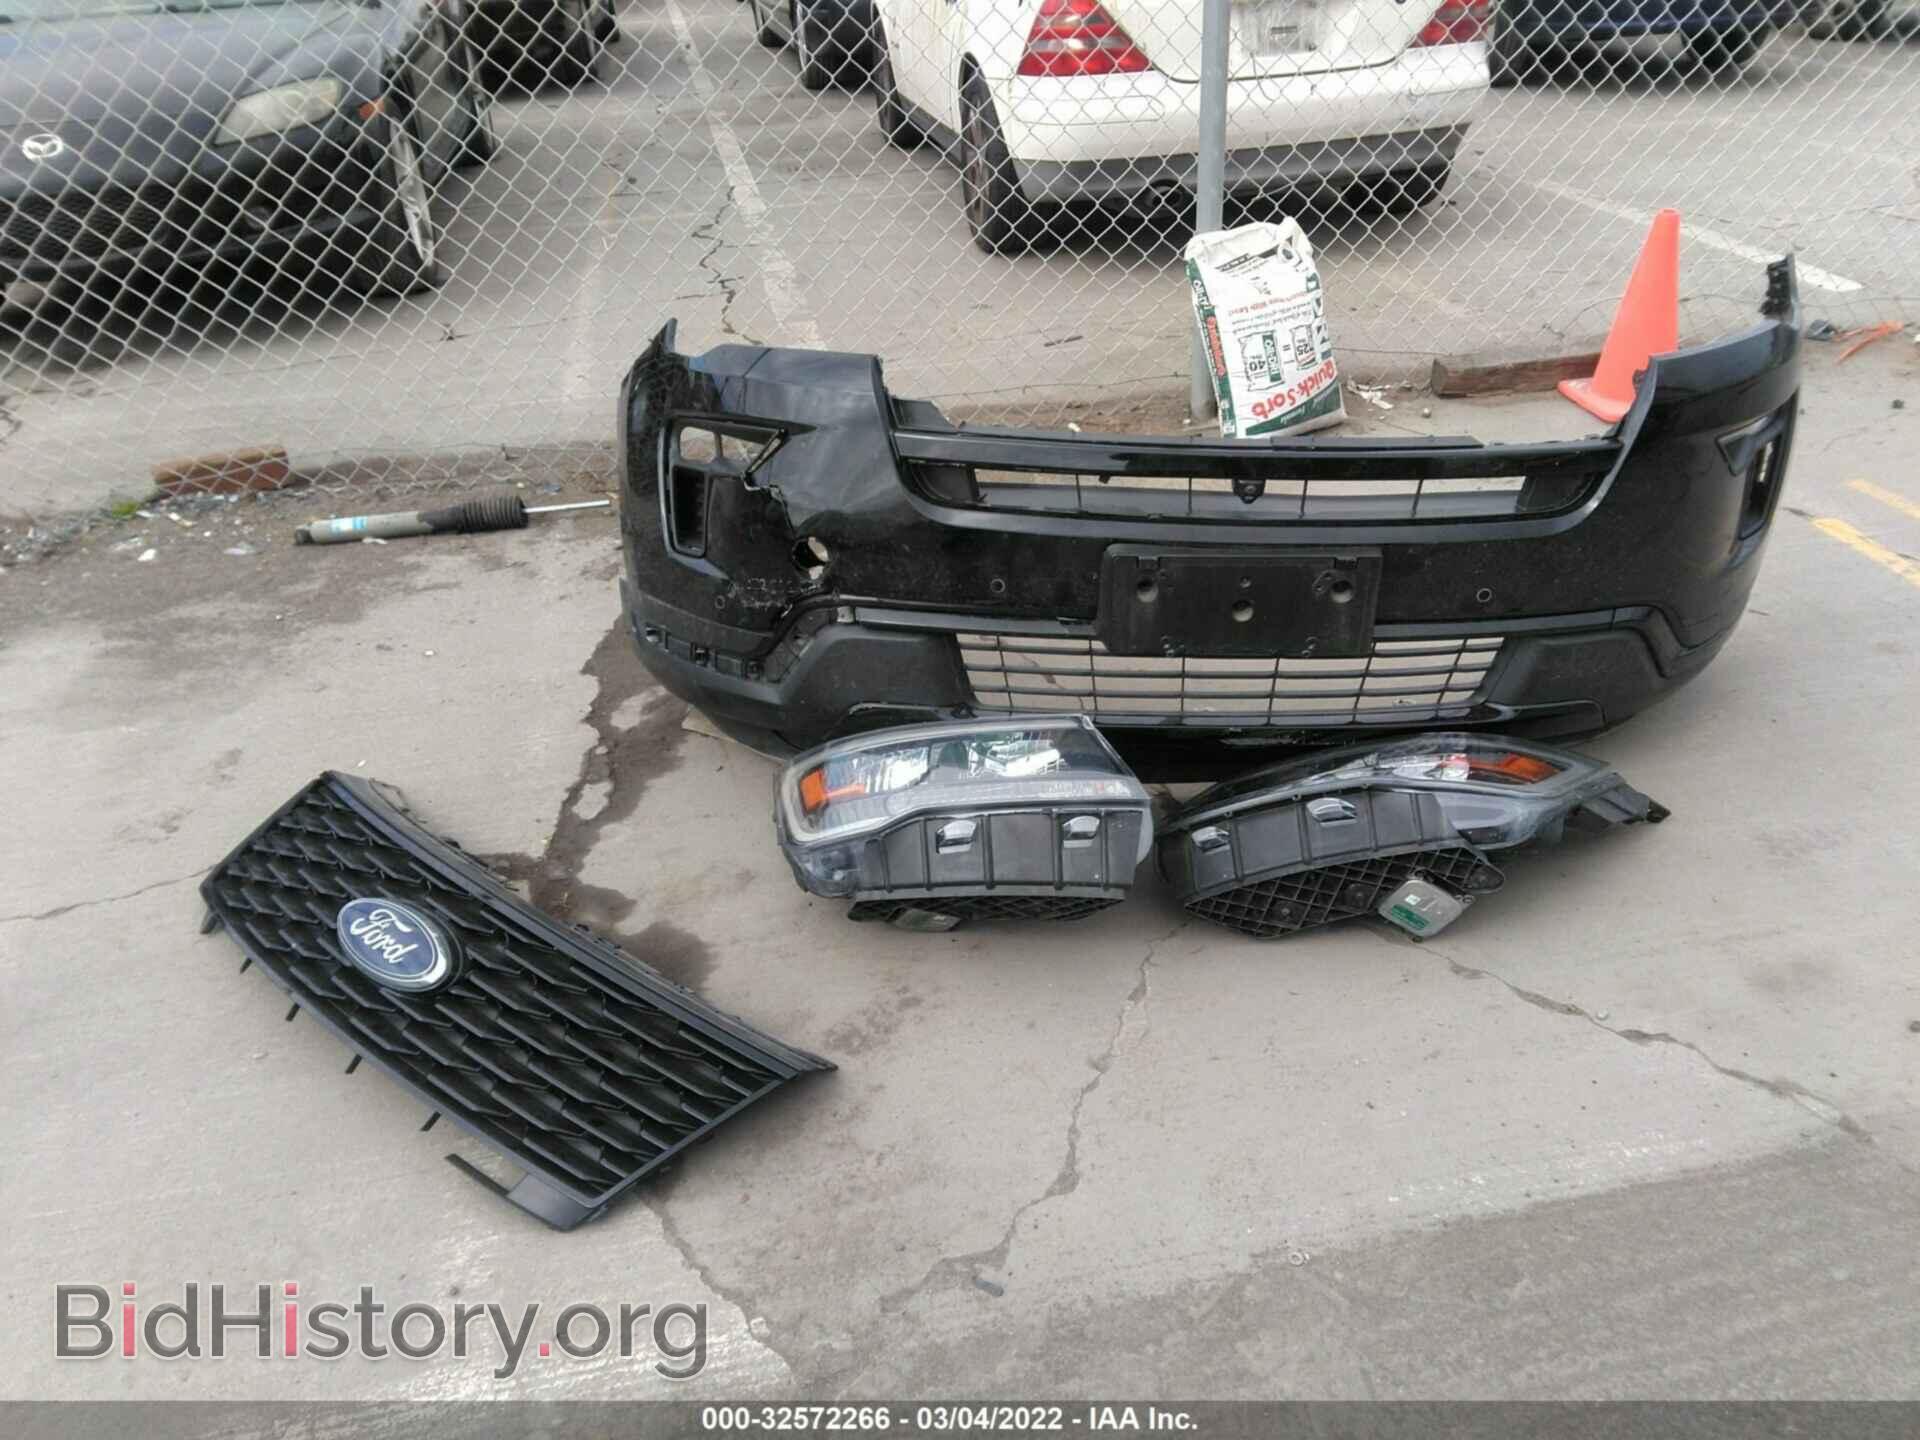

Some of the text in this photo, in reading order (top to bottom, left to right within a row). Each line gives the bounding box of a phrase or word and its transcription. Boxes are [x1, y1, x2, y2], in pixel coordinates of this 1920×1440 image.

[1249, 359, 1266, 372] 40
[1251, 359, 1336, 420] Quick-Sorb
[349, 908, 419, 964] Ford
